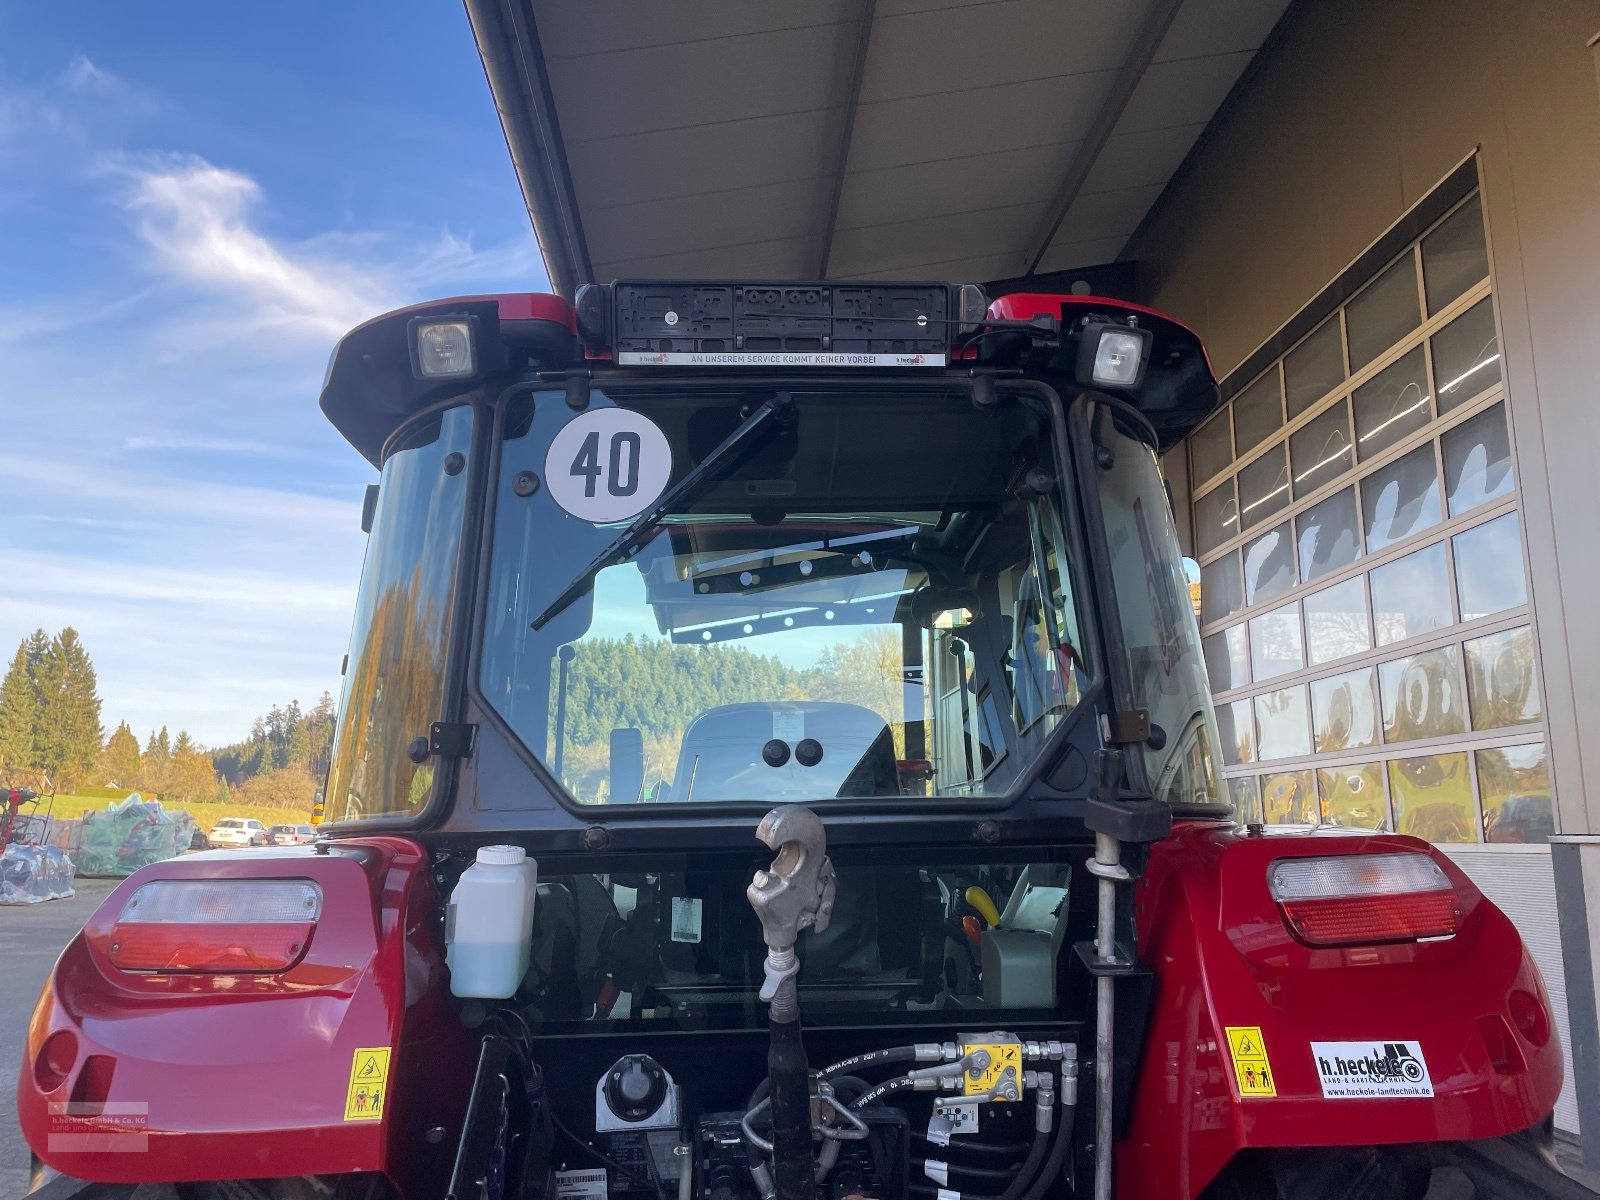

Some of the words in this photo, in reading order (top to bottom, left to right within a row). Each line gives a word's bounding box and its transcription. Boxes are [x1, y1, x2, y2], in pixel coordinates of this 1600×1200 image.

[691, 355, 703, 364] AN
[705, 355, 745, 364] UNSEREM
[747, 355, 780, 364] SERVICE
[782, 355, 813, 364] KOMMT
[815, 355, 845, 364] KEINER
[847, 355, 876, 364] VORBEI
[570, 432, 640, 497] 40
[1318, 1056, 1403, 1076] h.heckele
[1326, 1087, 1430, 1096] www.heckele-landtechnik.de
